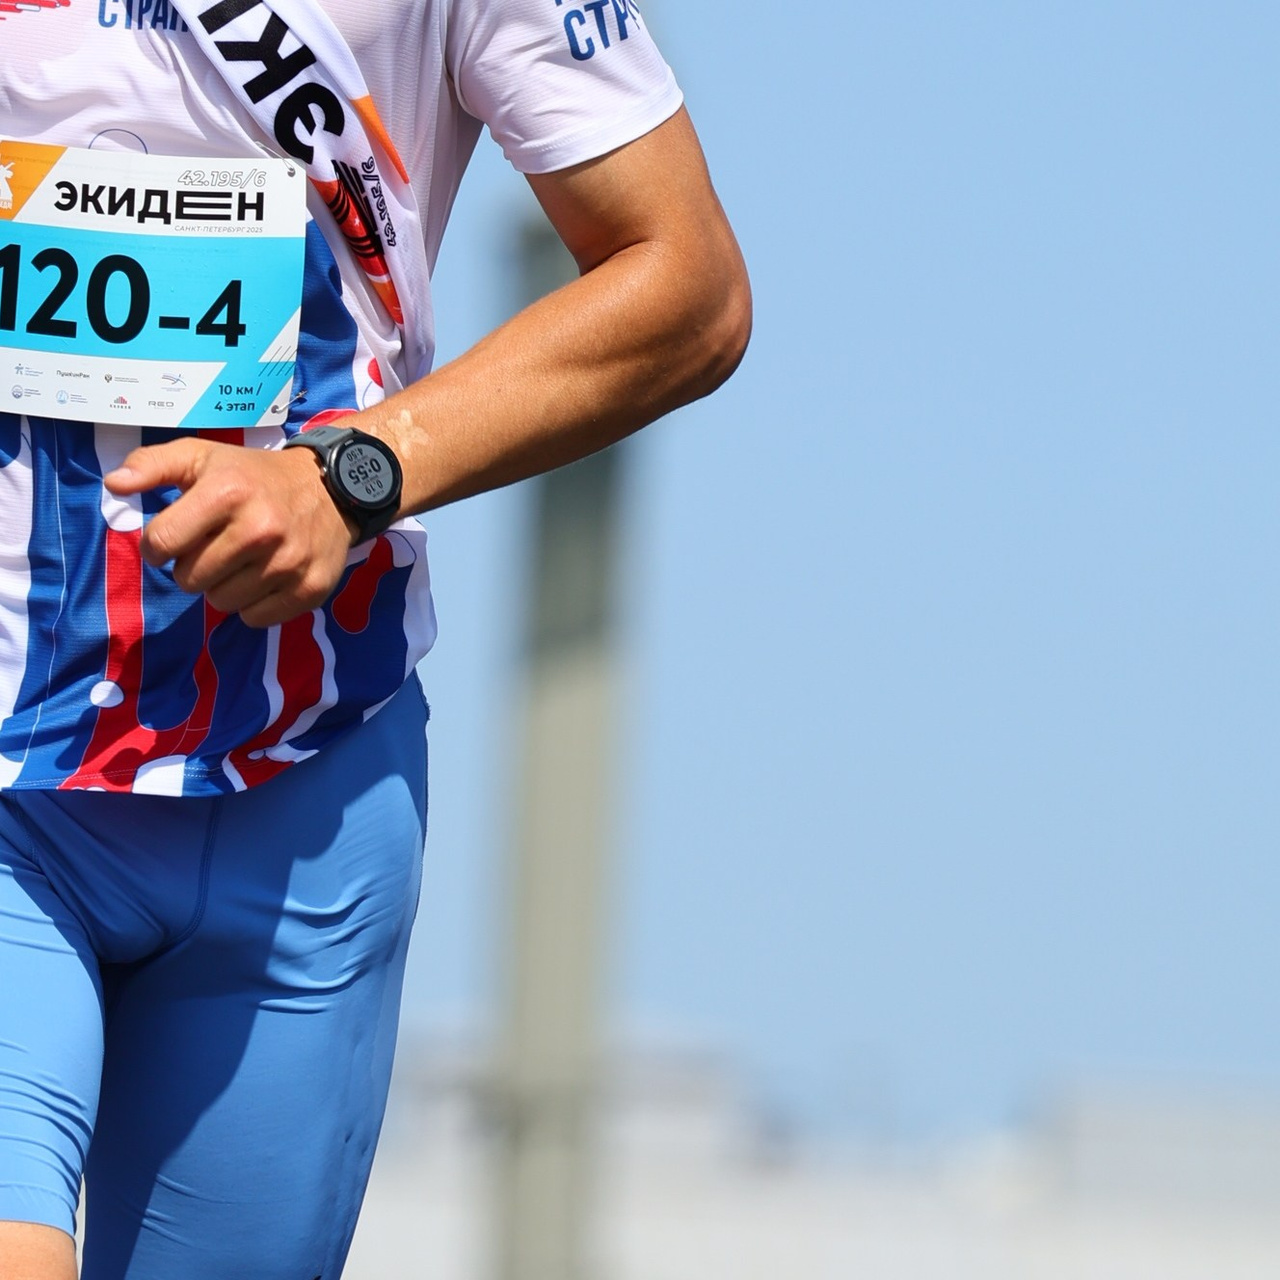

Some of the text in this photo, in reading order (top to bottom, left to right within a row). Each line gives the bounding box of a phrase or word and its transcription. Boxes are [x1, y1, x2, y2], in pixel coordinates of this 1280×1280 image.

[177, 168, 267, 189] 42.195/6
[53, 180, 264, 225] ЭКИДЕН
[174, 224, 263, 234] САНКТ-ПЕТЕРБУРГ 2025
[218, 384, 232, 395] 10
[236, 385, 254, 395] км
[214, 401, 255, 412] 4 этап
